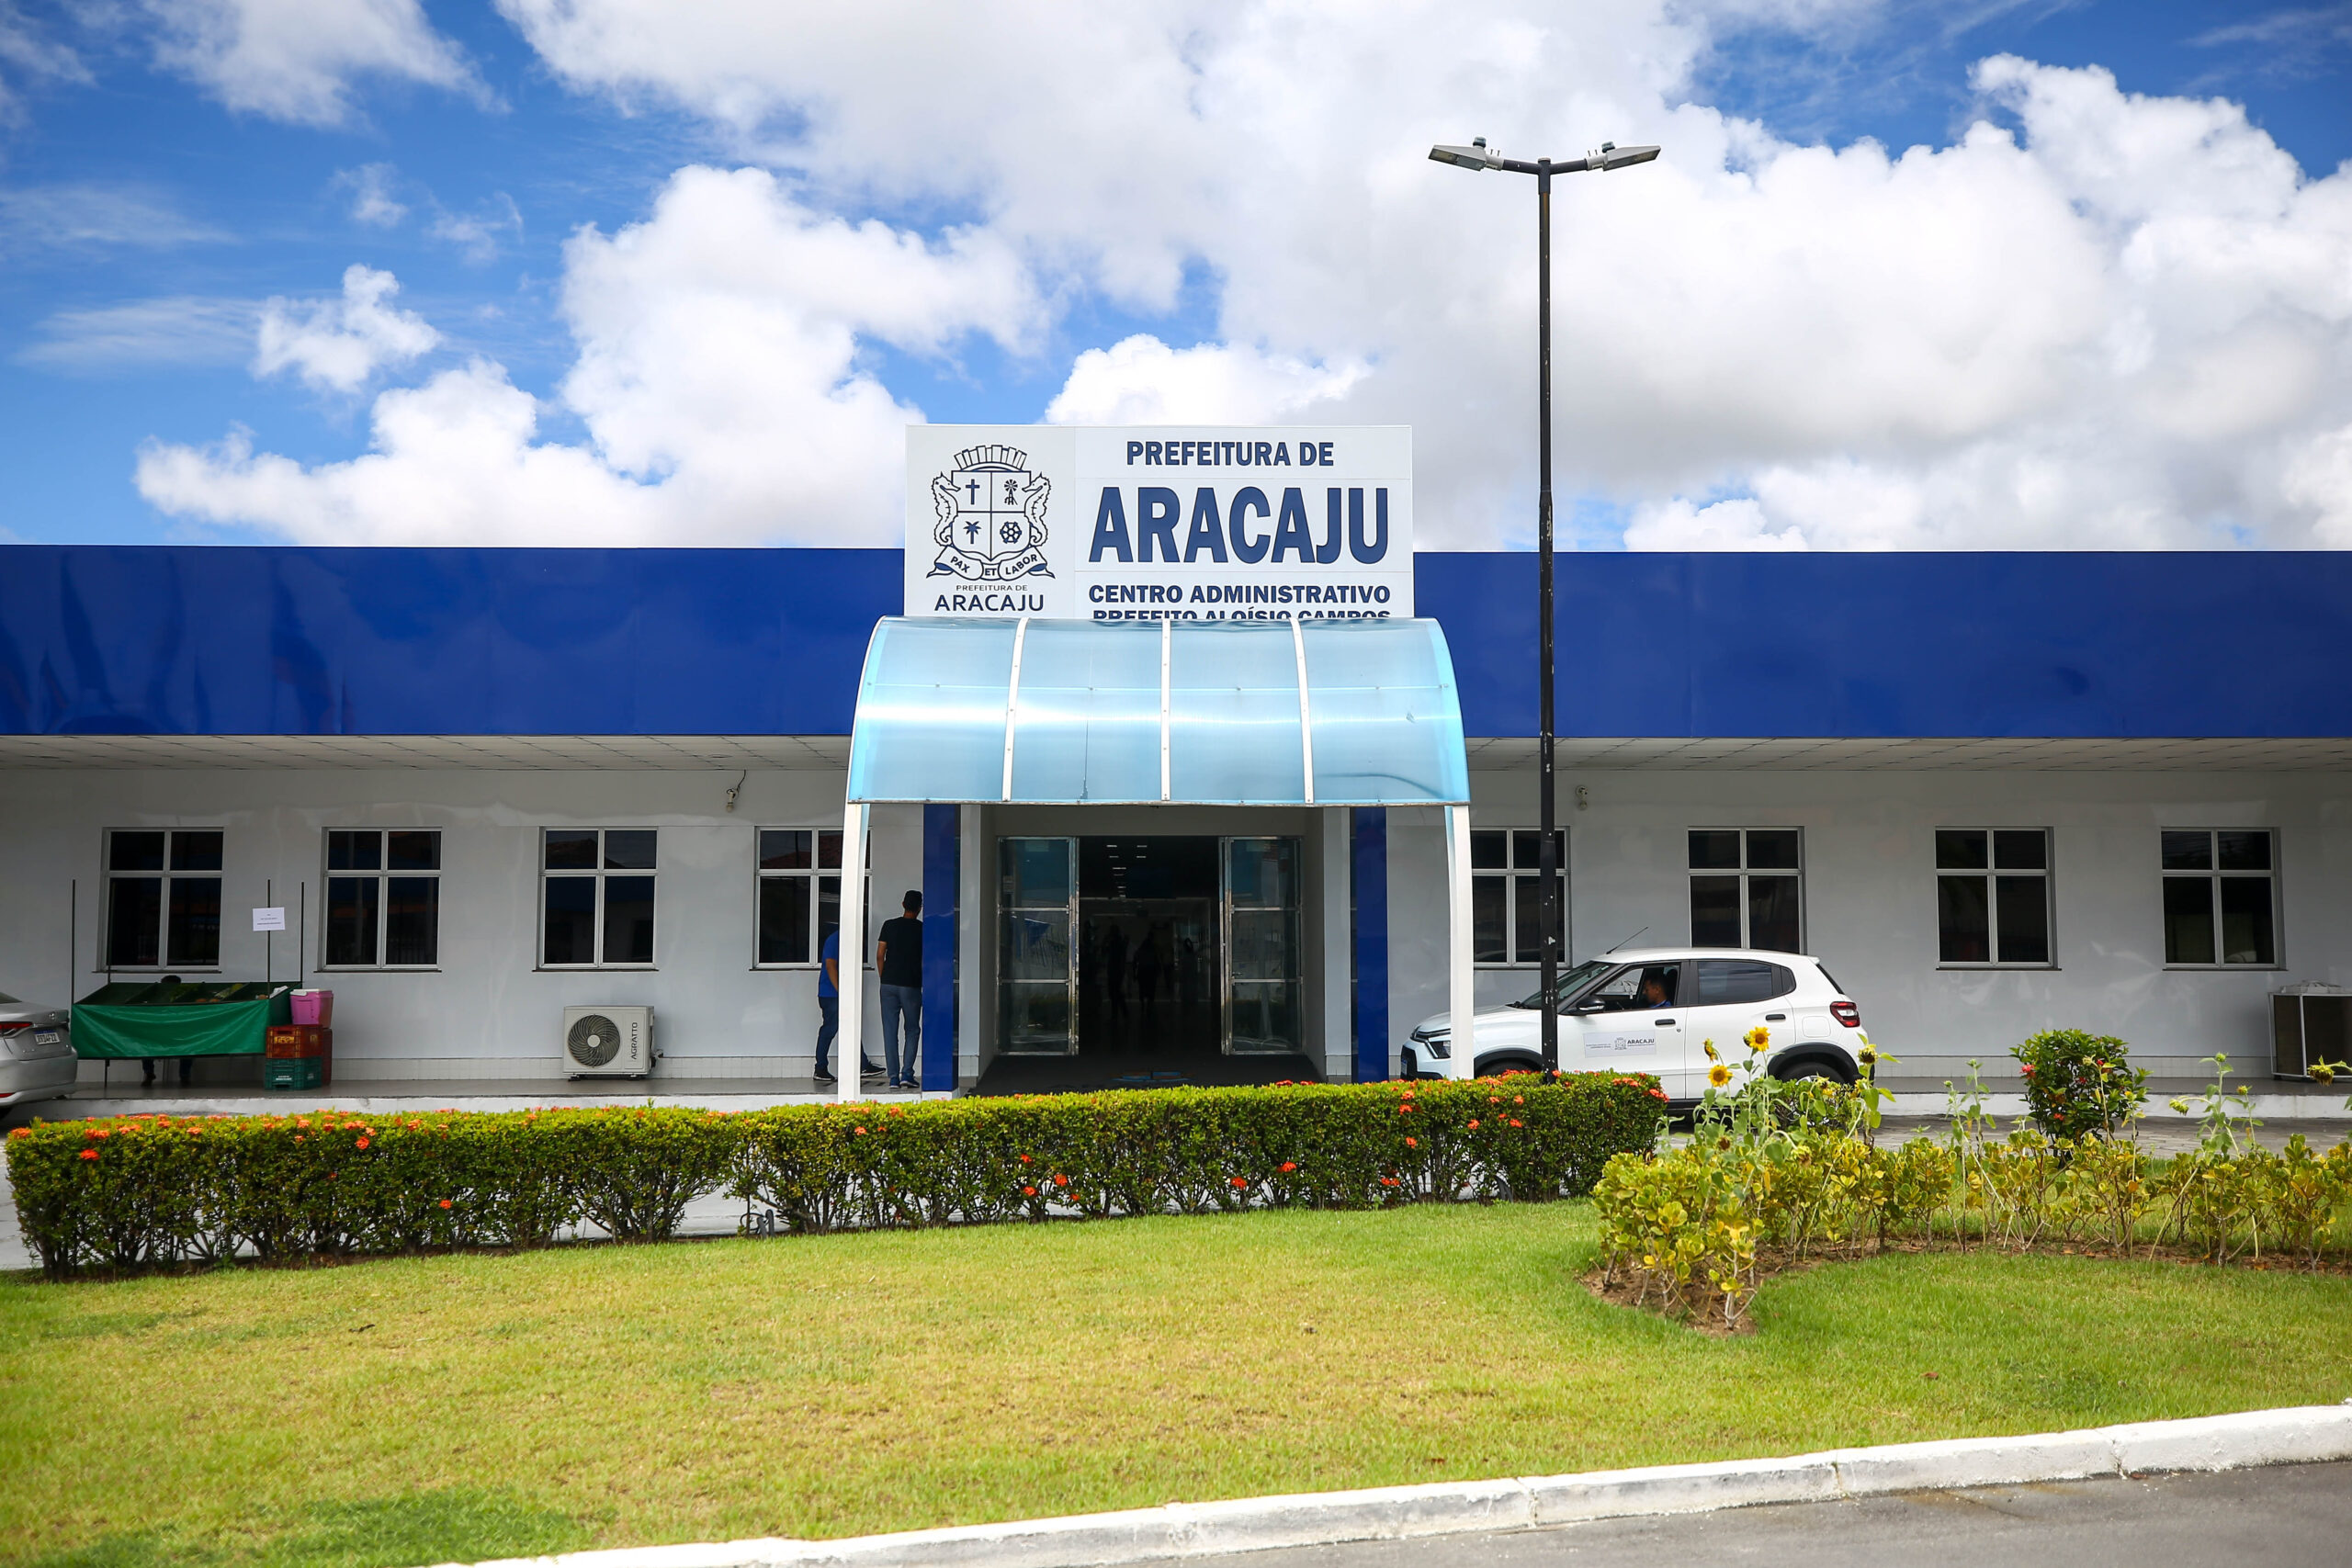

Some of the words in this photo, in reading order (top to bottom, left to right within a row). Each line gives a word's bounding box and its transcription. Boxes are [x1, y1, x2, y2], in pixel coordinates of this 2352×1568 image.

[1126, 441, 1292, 466] PREFEITURA
[1299, 442, 1334, 466] DE
[1089, 486, 1388, 564] ARACAJU
[950, 556, 970, 574] PAX
[984, 568, 997, 576] ET
[1005, 554, 1038, 575] LABOR
[934, 594, 1044, 612] ARACAJU
[1089, 585, 1183, 603] CENTRO
[1190, 585, 1391, 604] ADMINISTRATIVO
